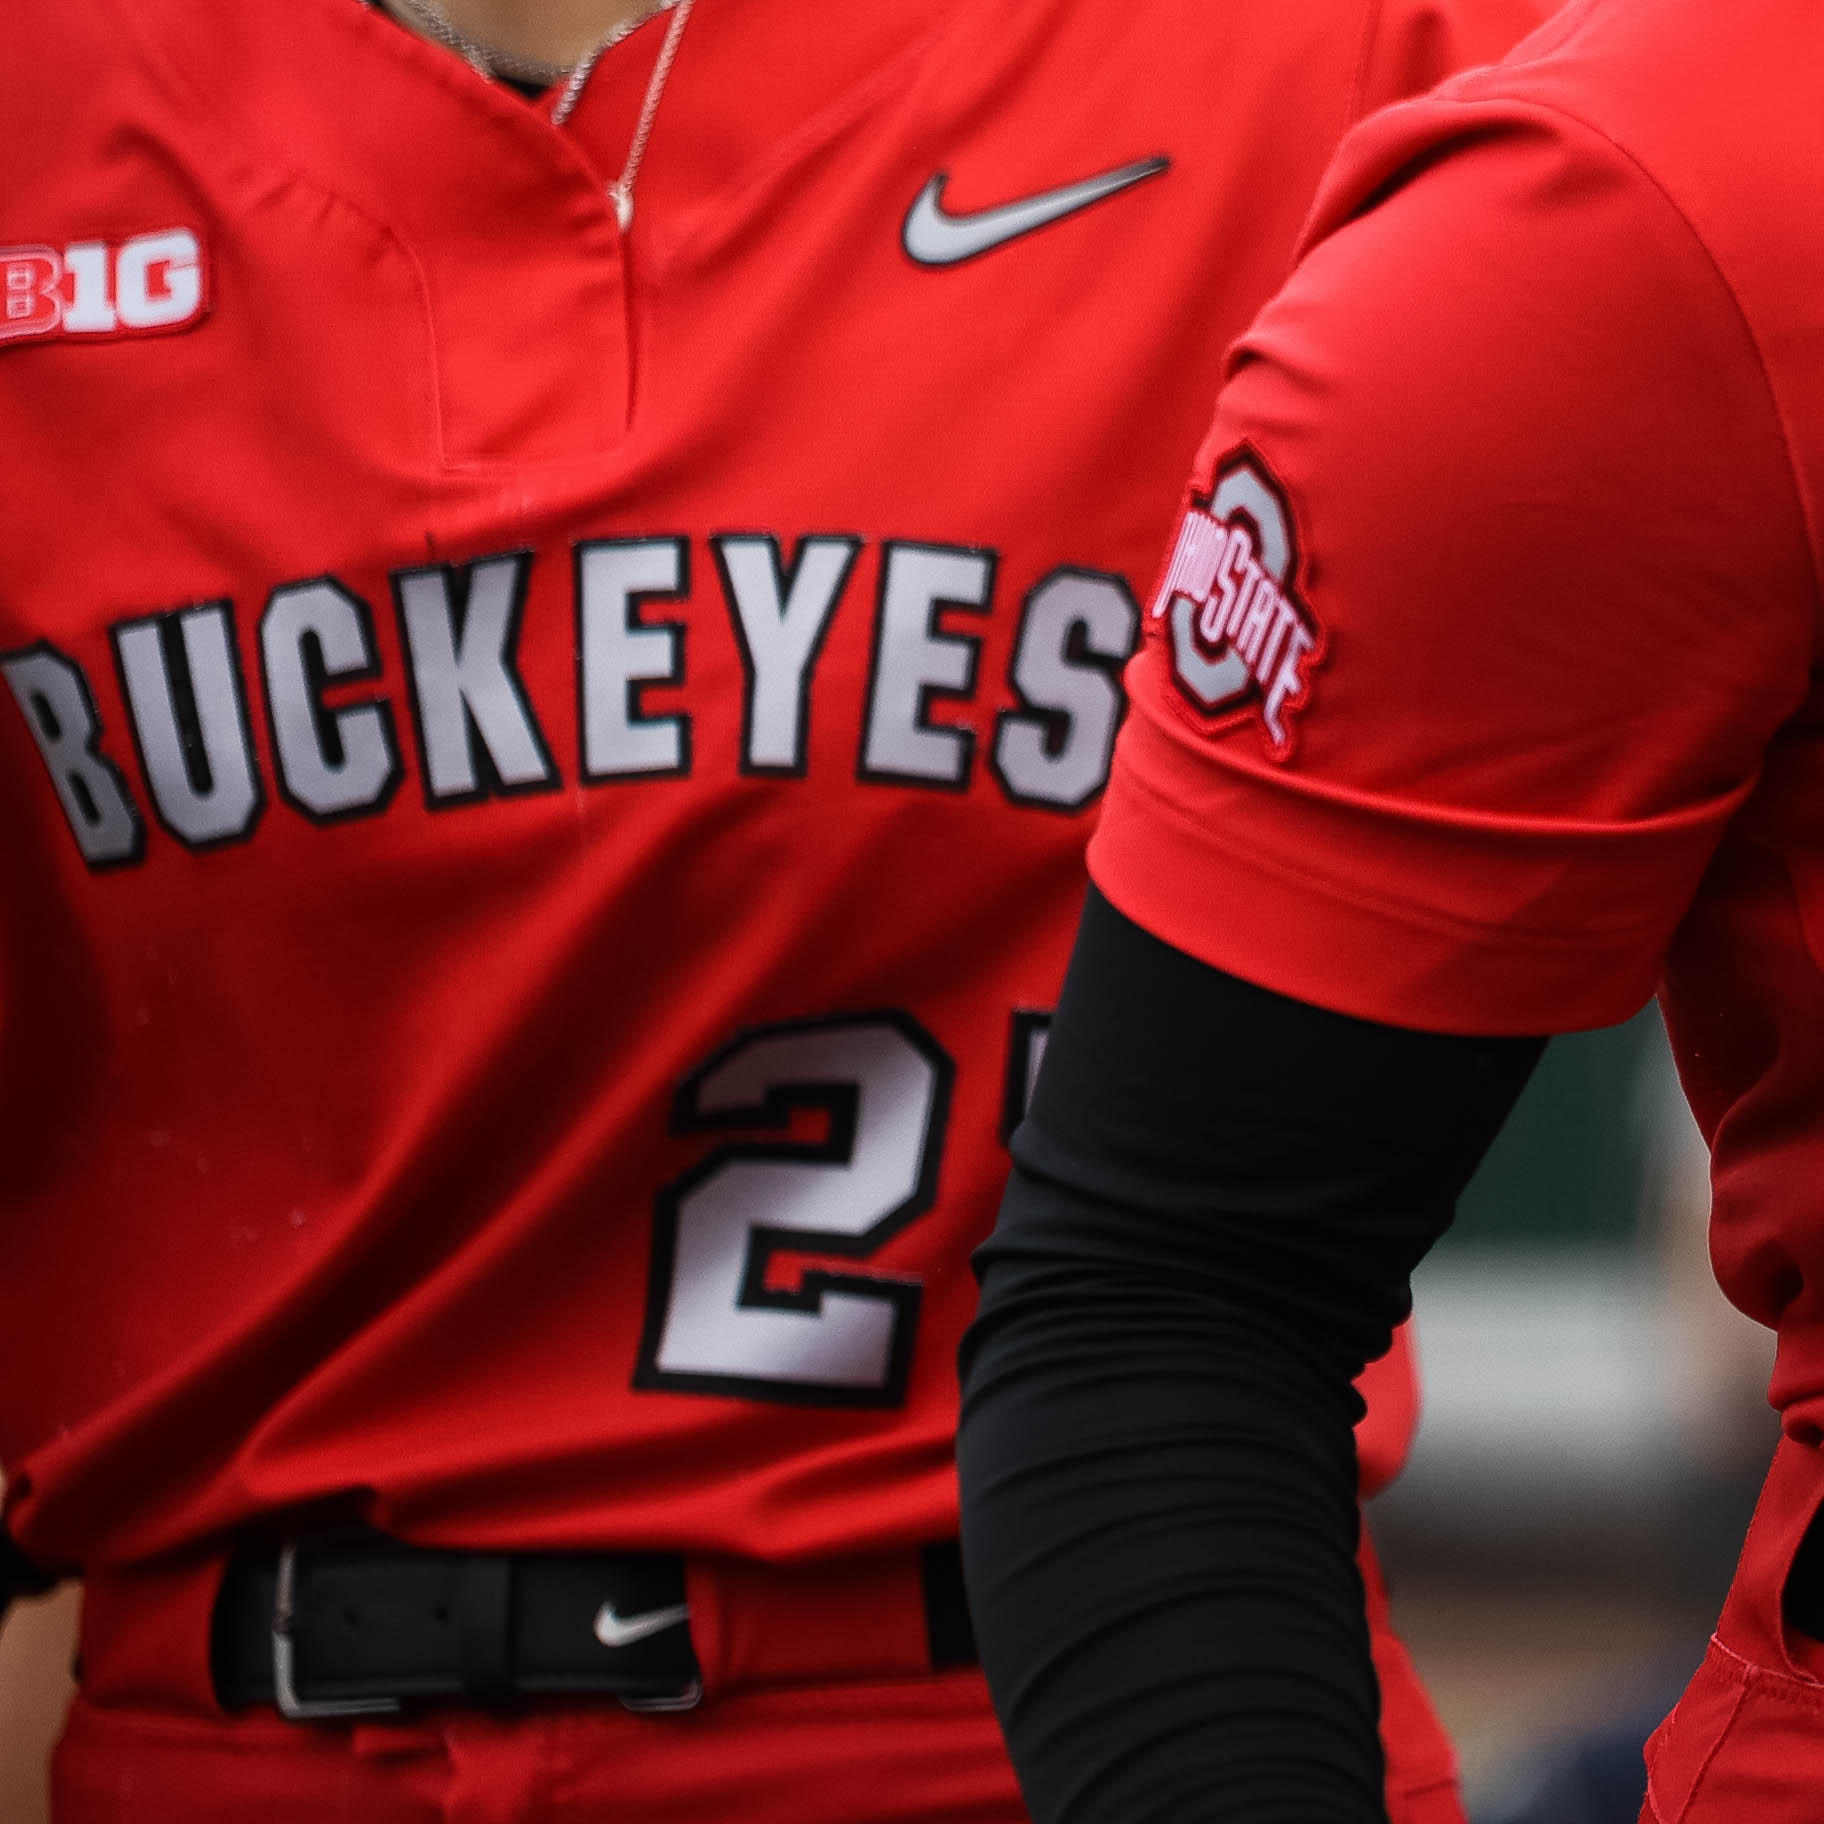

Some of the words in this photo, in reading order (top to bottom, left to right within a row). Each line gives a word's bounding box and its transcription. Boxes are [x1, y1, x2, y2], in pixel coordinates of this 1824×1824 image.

[0, 531, 1137, 870] BUCKEYES
[1200, 528, 1316, 745] STATE
[631, 1008, 1055, 1412] 2
